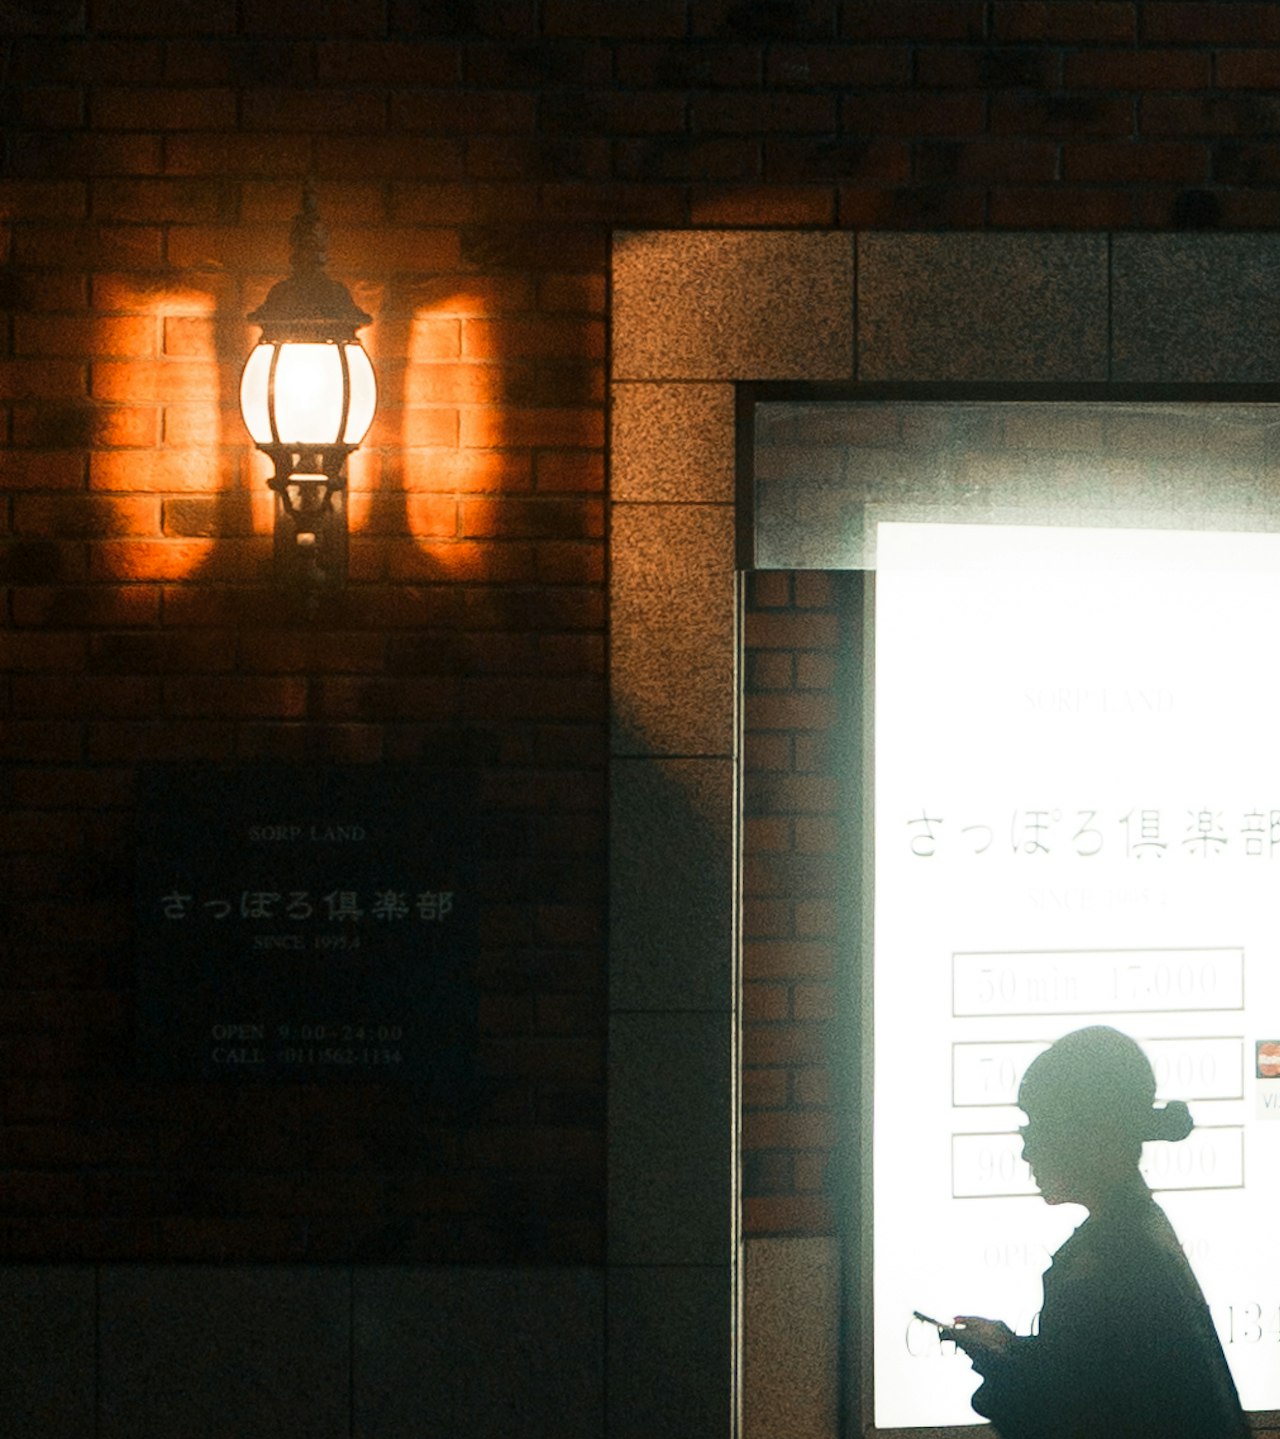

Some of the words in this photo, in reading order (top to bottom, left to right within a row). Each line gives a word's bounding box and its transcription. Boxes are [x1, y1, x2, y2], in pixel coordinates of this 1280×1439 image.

[1101, 686, 1175, 714] LAND
[249, 824, 302, 843] SORP
[310, 824, 366, 843] LAND
[159, 888, 455, 924] さっぽろ倶楽部
[253, 934, 306, 951] SINCE
[211, 1023, 266, 1041] OPEN
[211, 1047, 266, 1066] CALL
